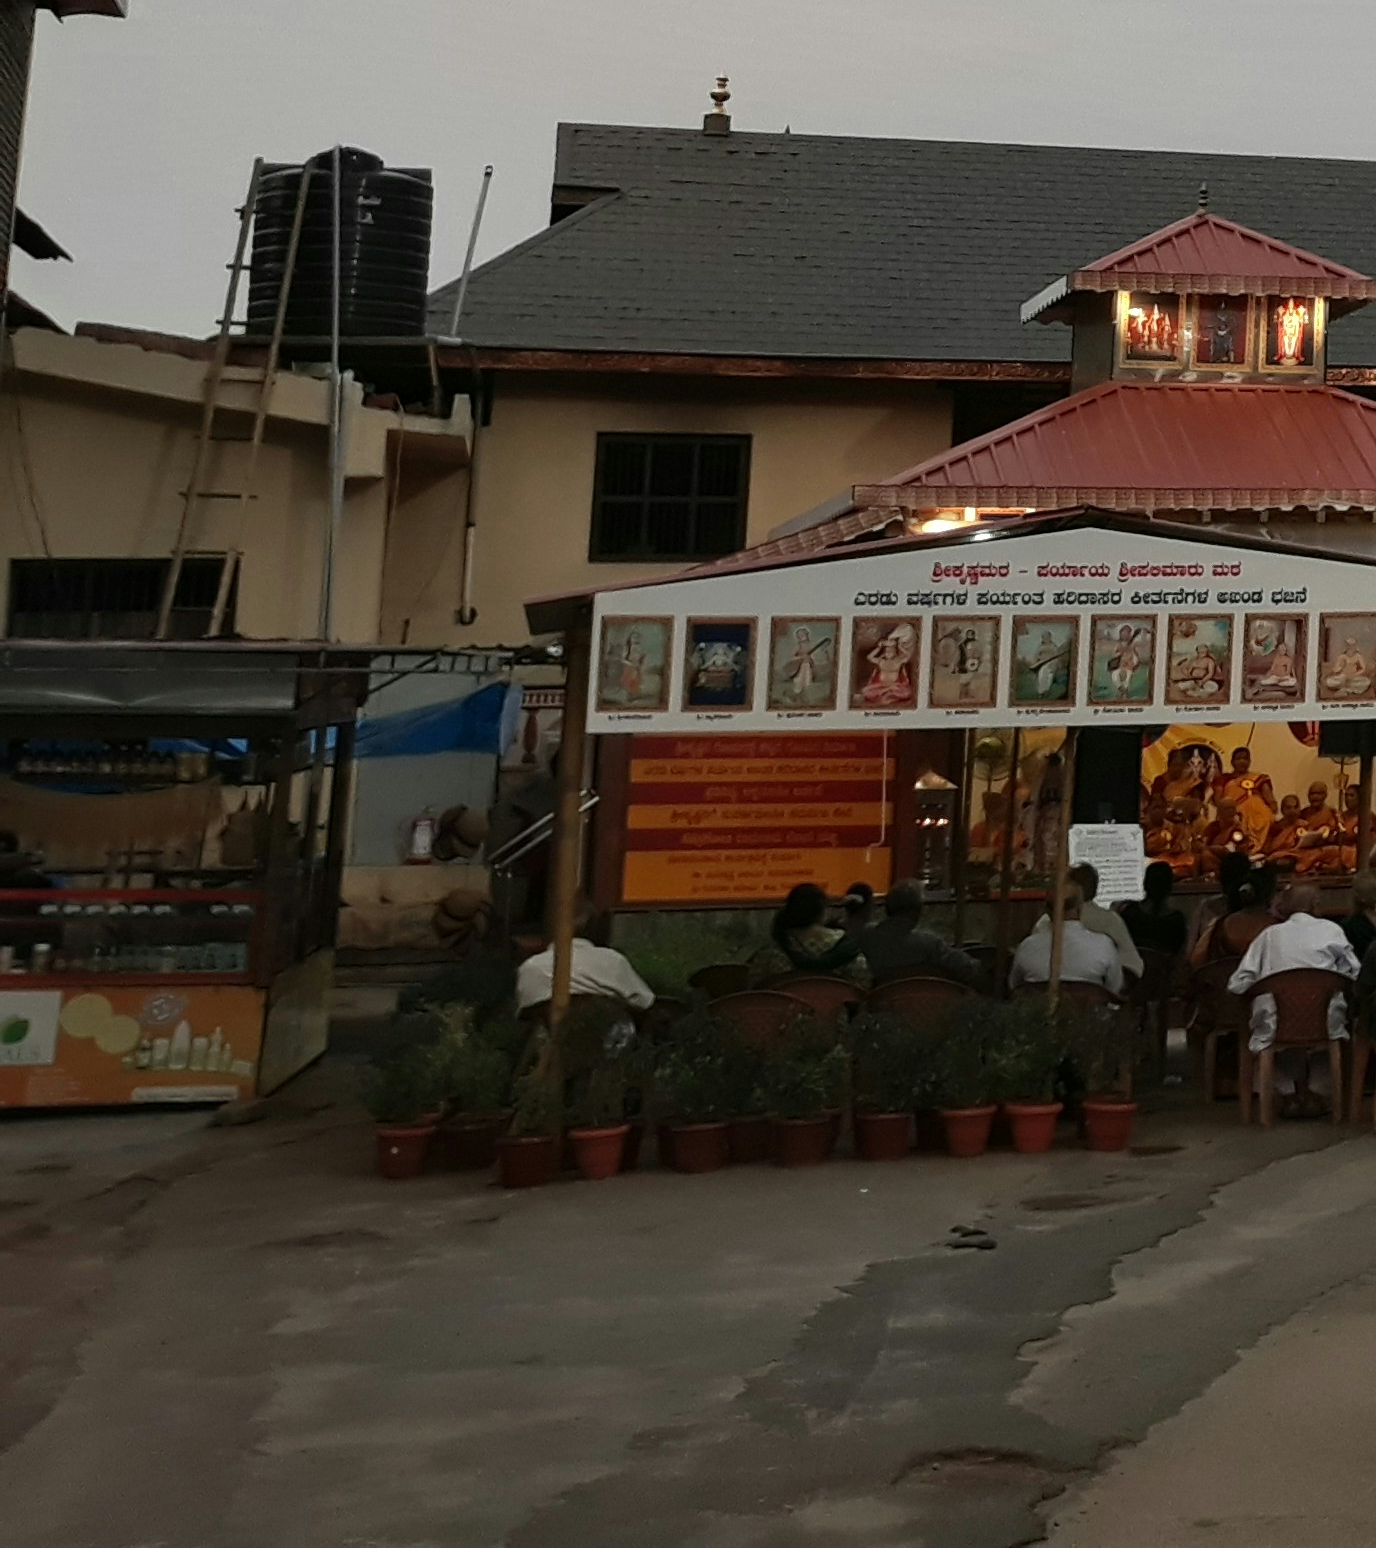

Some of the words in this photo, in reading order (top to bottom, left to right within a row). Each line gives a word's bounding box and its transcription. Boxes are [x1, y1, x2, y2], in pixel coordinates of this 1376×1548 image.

[1036, 561, 1111, 580] ಪರ್ಯಾಯ
[1211, 561, 1242, 579] ಮಠ
[853, 589, 899, 607] ಎರಡು
[906, 588, 968, 608] ವರ್ಷಗಳ
[976, 588, 1045, 607] ಪರ್ಯಂತ
[1052, 588, 1122, 606] ಹರಿದಾಸರ
[1130, 587, 1209, 606] ಕೀರ್ತನೆಗಳ
[1271, 587, 1308, 606] ಭಜನೆ
